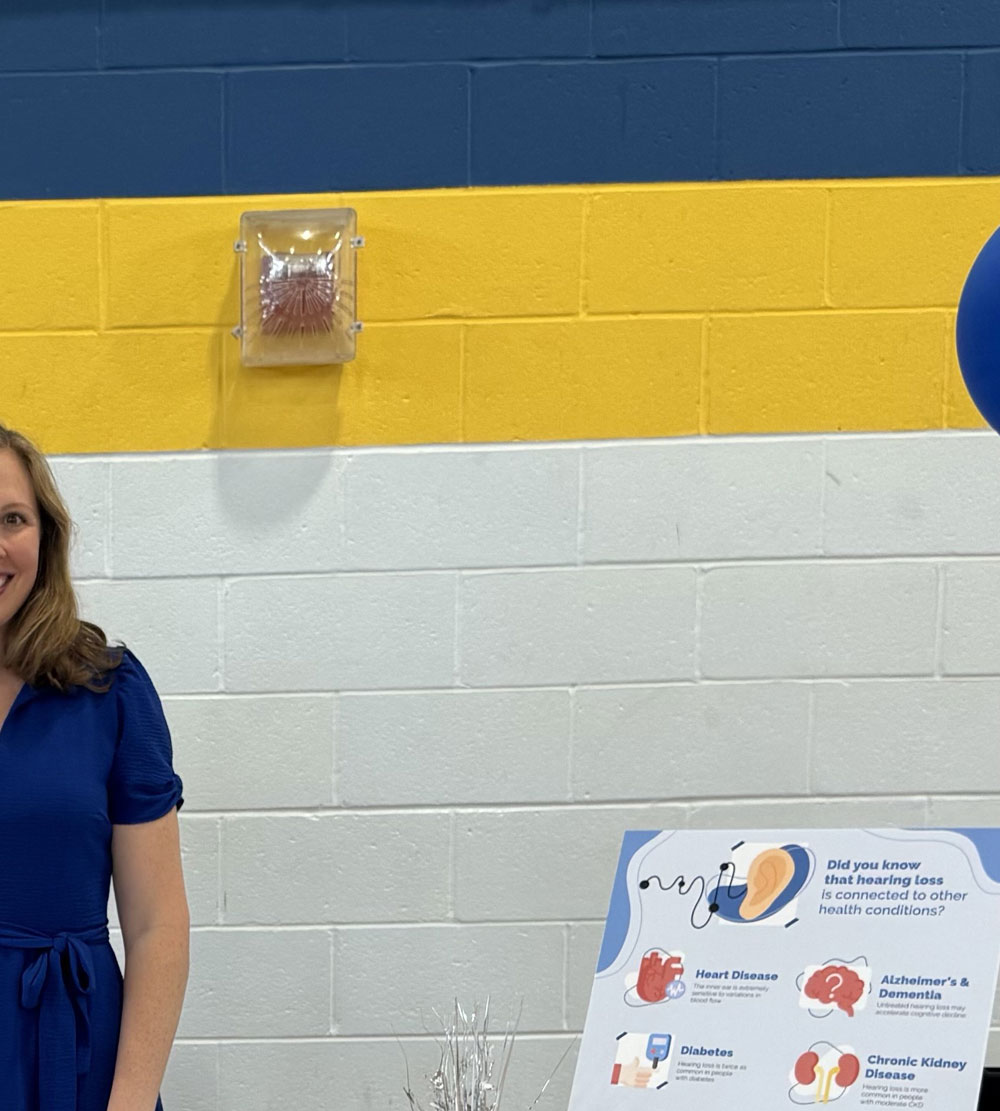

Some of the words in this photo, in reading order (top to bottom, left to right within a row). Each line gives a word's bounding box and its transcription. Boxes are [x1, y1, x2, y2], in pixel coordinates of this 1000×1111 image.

[827, 860, 850, 870] Did
[853, 861, 878, 872] you
[882, 860, 921, 870] know
[825, 875, 853, 885] that
[856, 875, 911, 887] hearing
[915, 875, 943, 885] loss
[822, 889, 832, 899] is
[835, 889, 909, 900] connected
[913, 891, 926, 900] to
[930, 890, 968, 900] other
[819, 904, 861, 914] health
[865, 905, 945, 916] conditions?
[696, 969, 728, 979] Heart
[732, 970, 778, 980] Disease
[881, 975, 957, 986] Alzheimer's
[960, 978, 969, 987] &
[879, 988, 942, 1000] Dementia
[680, 1046, 733, 1057] Diabetes
[868, 1055, 918, 1066] Chronic
[921, 1058, 967, 1071] Kidney
[865, 1069, 915, 1080] Disease
